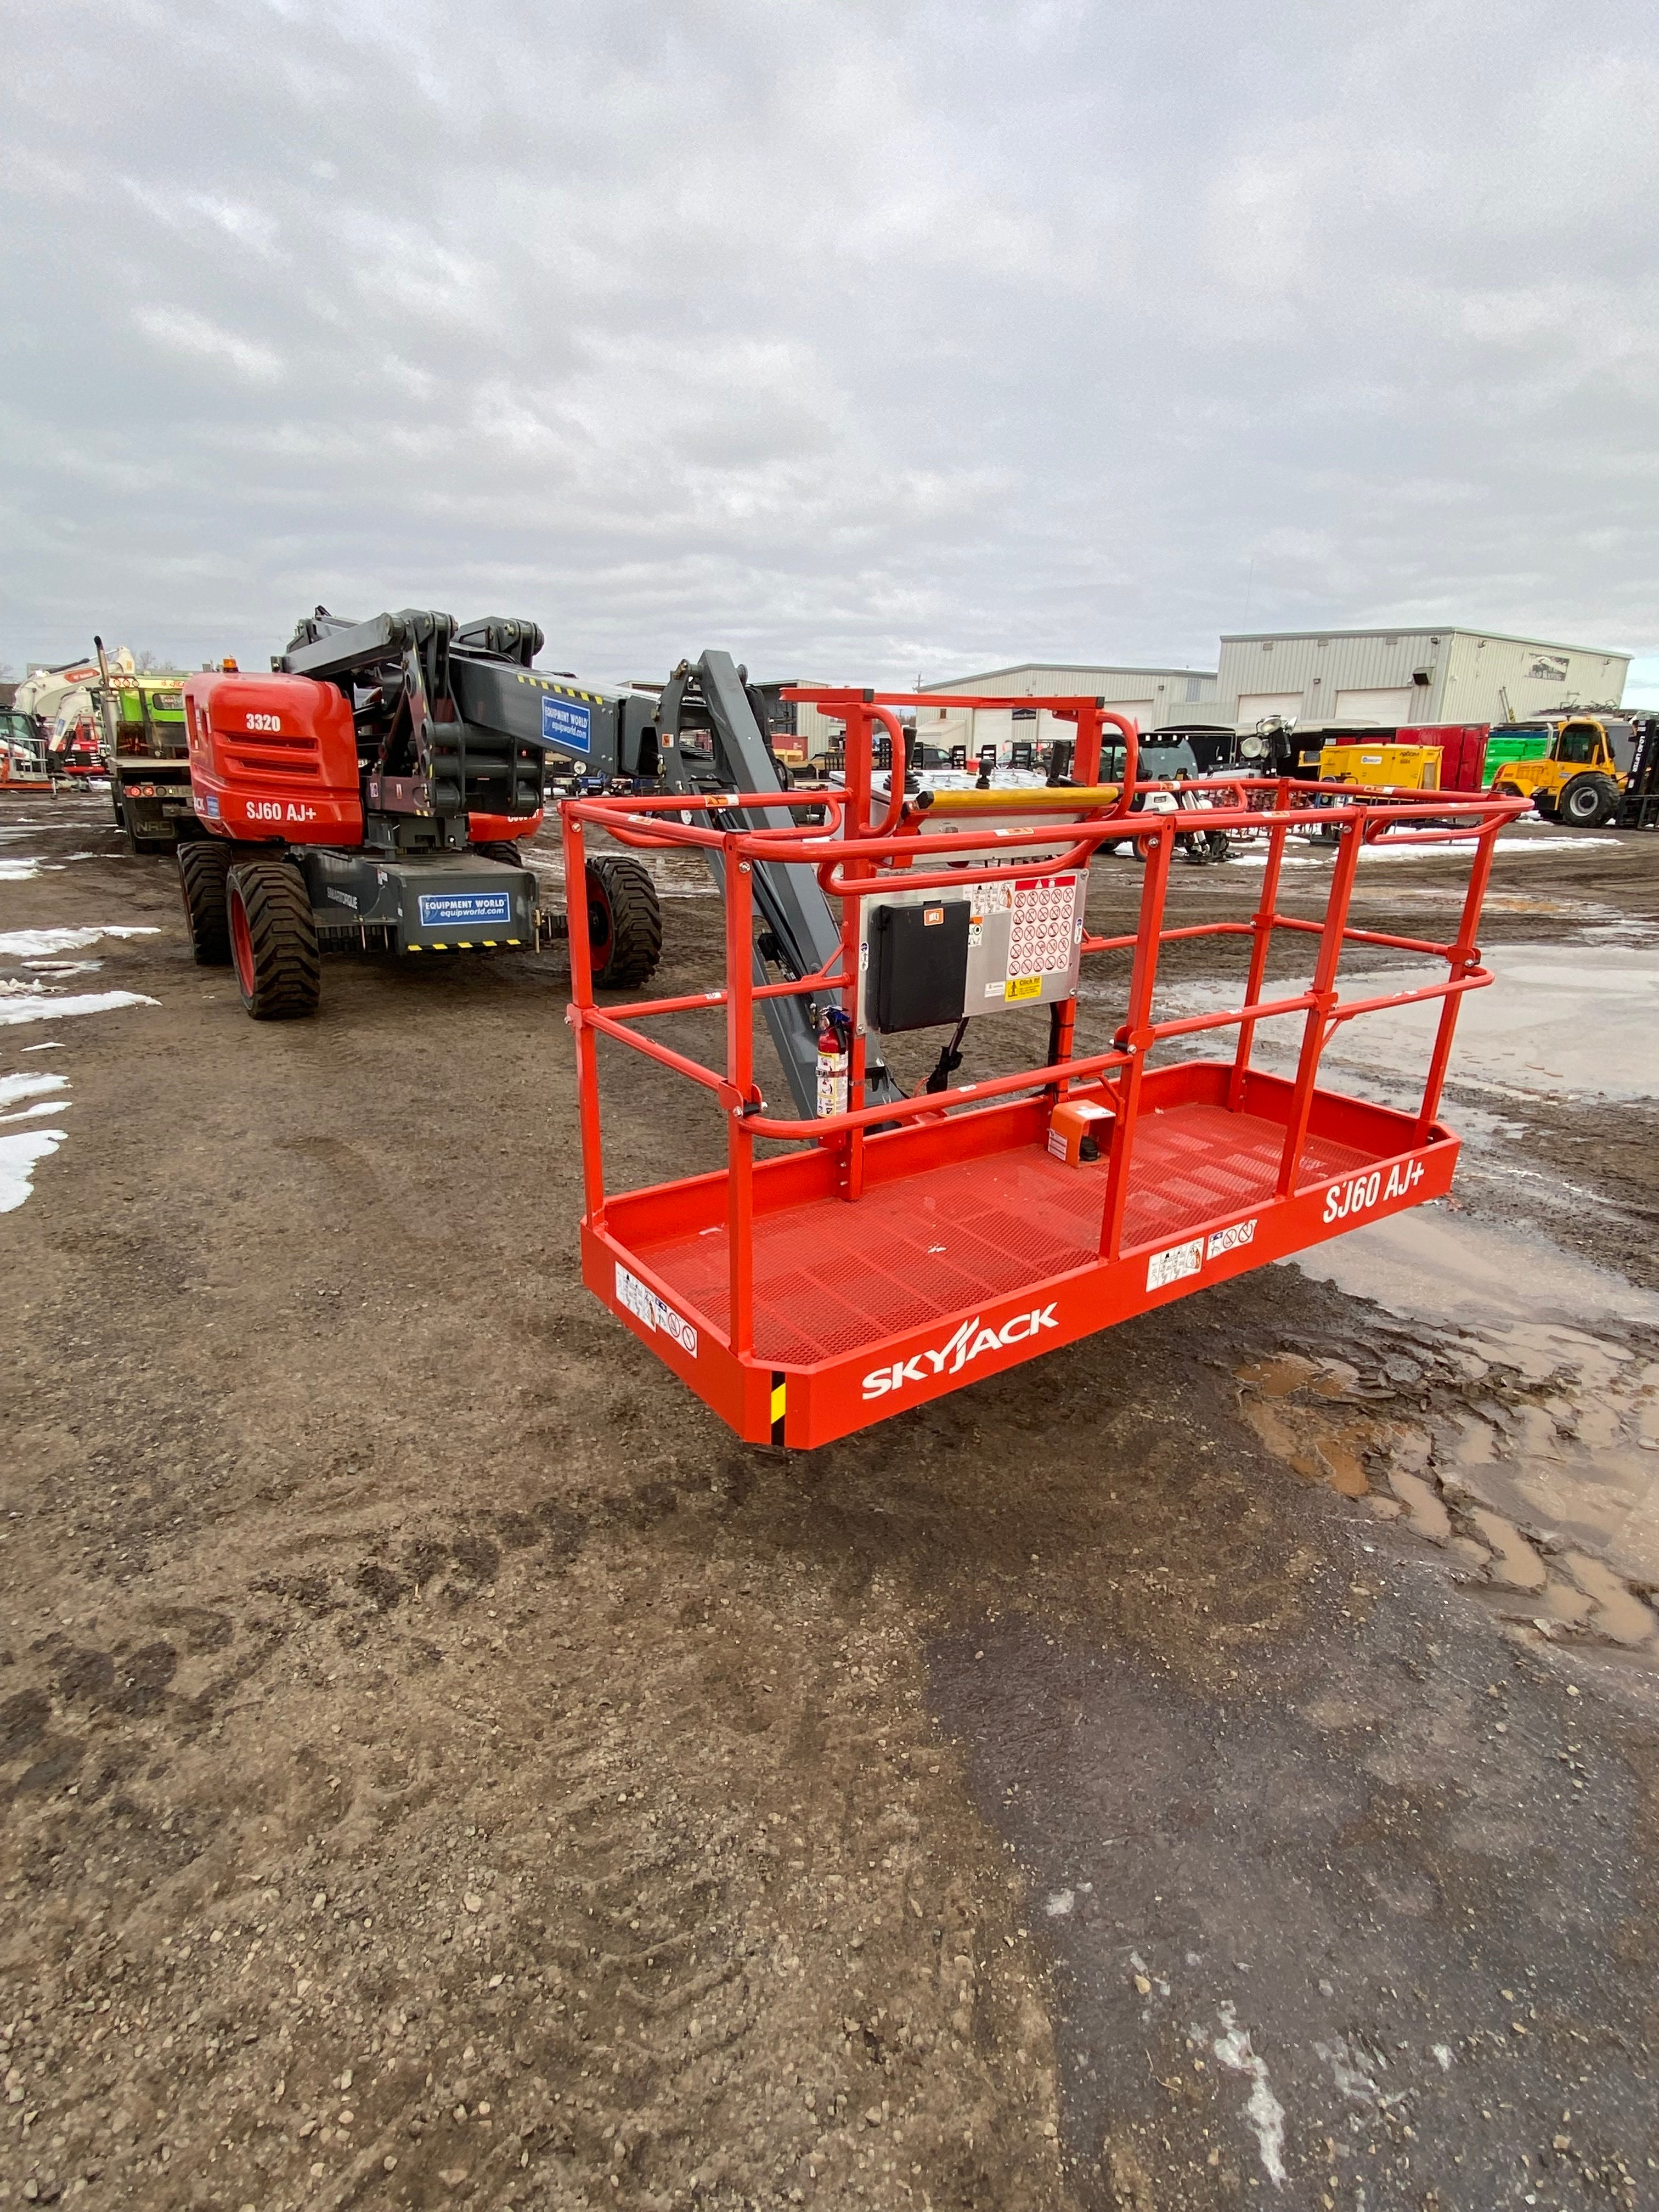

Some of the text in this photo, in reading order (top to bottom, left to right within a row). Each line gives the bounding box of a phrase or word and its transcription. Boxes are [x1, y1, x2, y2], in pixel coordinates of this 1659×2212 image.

[246, 713, 281, 732] 3320
[545, 706, 588, 729] EQUIPMENT WORLD
[552, 721, 587, 740] equipworld.com
[1637, 736, 1646, 753] LOAD
[246, 802, 317, 821] SJ60 AJ+
[425, 899, 505, 910] EQUIPMENT WORLD
[440, 907, 504, 918] equipworld.com
[1323, 1159, 1425, 1224] SJ60 AJ+
[862, 1301, 1060, 1400] SKYJACK
